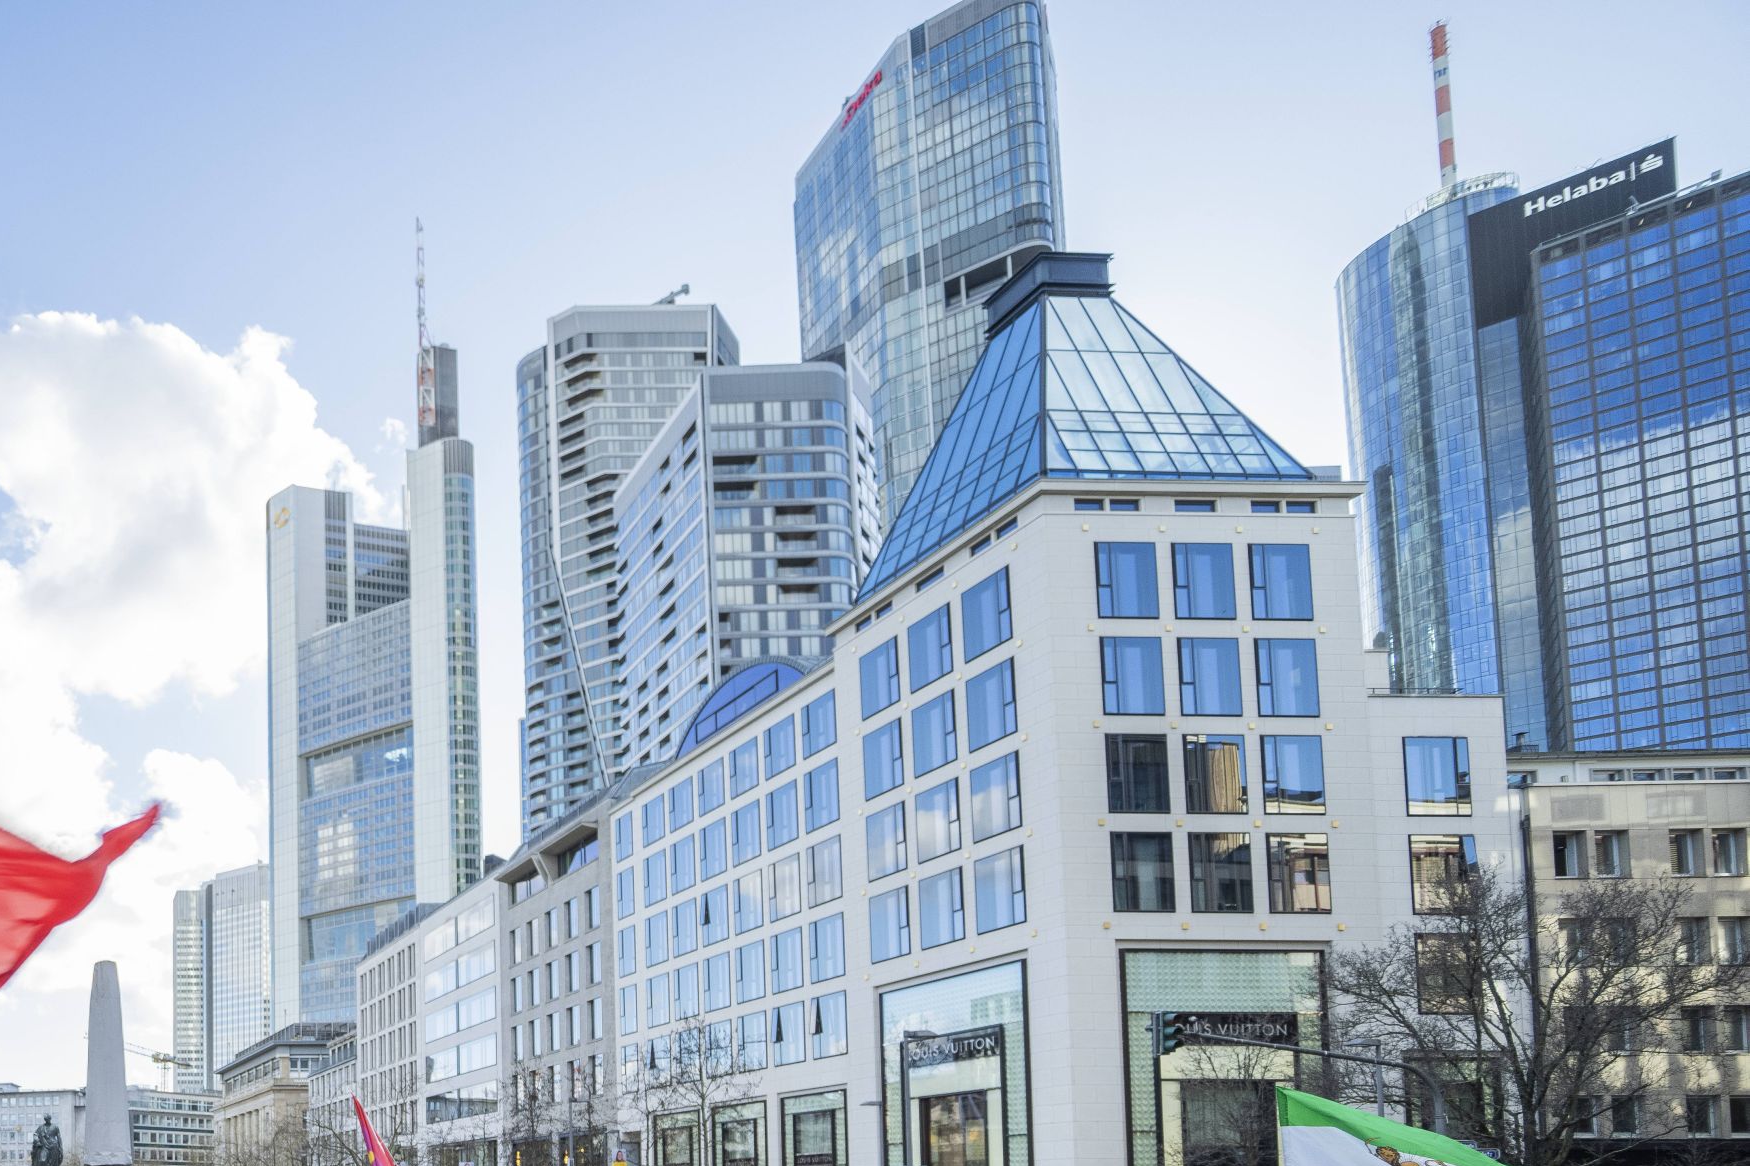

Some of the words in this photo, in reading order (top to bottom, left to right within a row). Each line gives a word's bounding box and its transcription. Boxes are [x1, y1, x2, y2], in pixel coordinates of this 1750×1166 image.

[1523, 170, 1626, 218] Helaba
[1218, 1023, 1288, 1037] VUITTON
[944, 1036, 995, 1054] VUITTON
